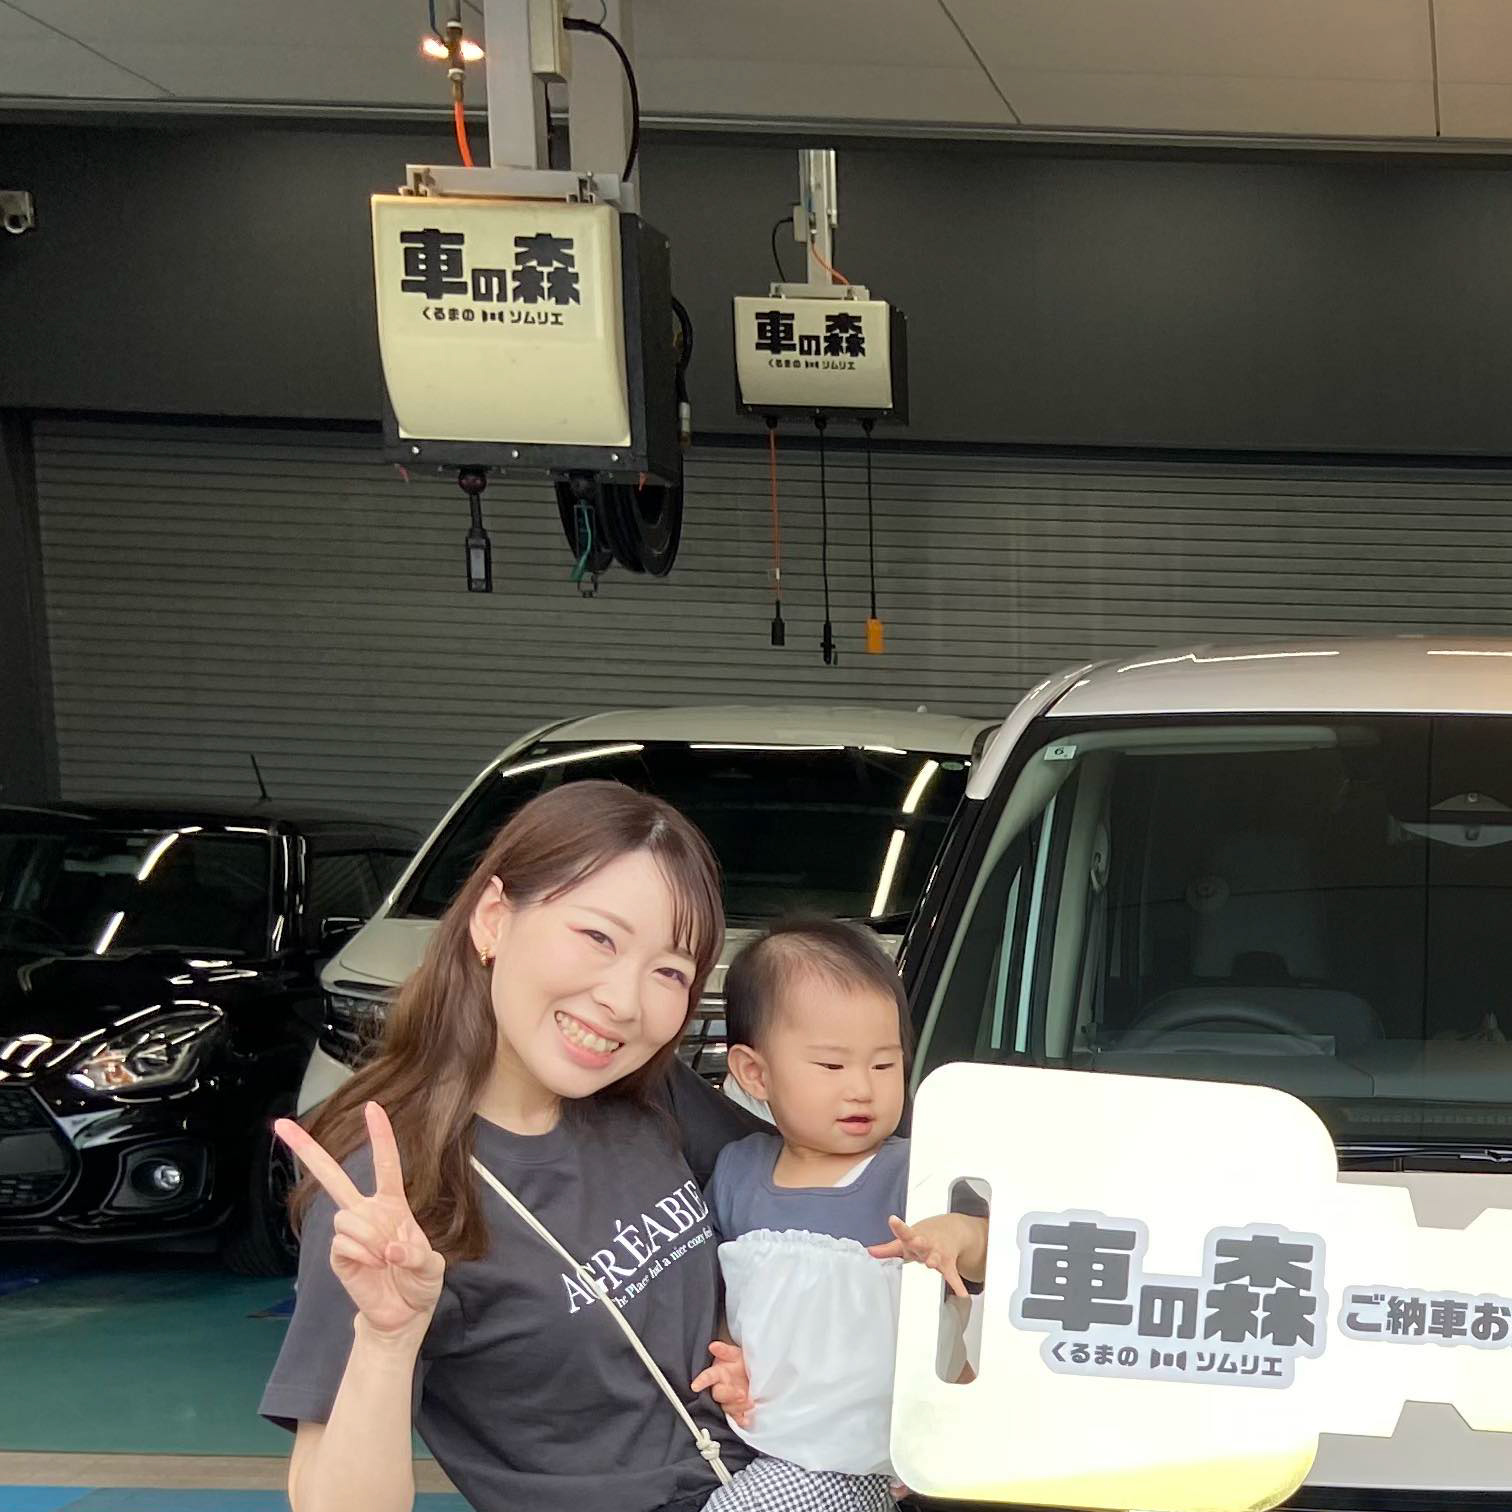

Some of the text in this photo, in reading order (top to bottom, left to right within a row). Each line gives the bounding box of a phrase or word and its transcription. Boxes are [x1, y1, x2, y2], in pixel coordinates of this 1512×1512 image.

[400, 228, 581, 305] 車の森
[422, 306, 564, 325] くるまの ソムリエ
[755, 310, 866, 357] 車の森
[1021, 1221, 1317, 1346] 車の森
[1052, 1341, 1283, 1377] くるまの ソムリエ
